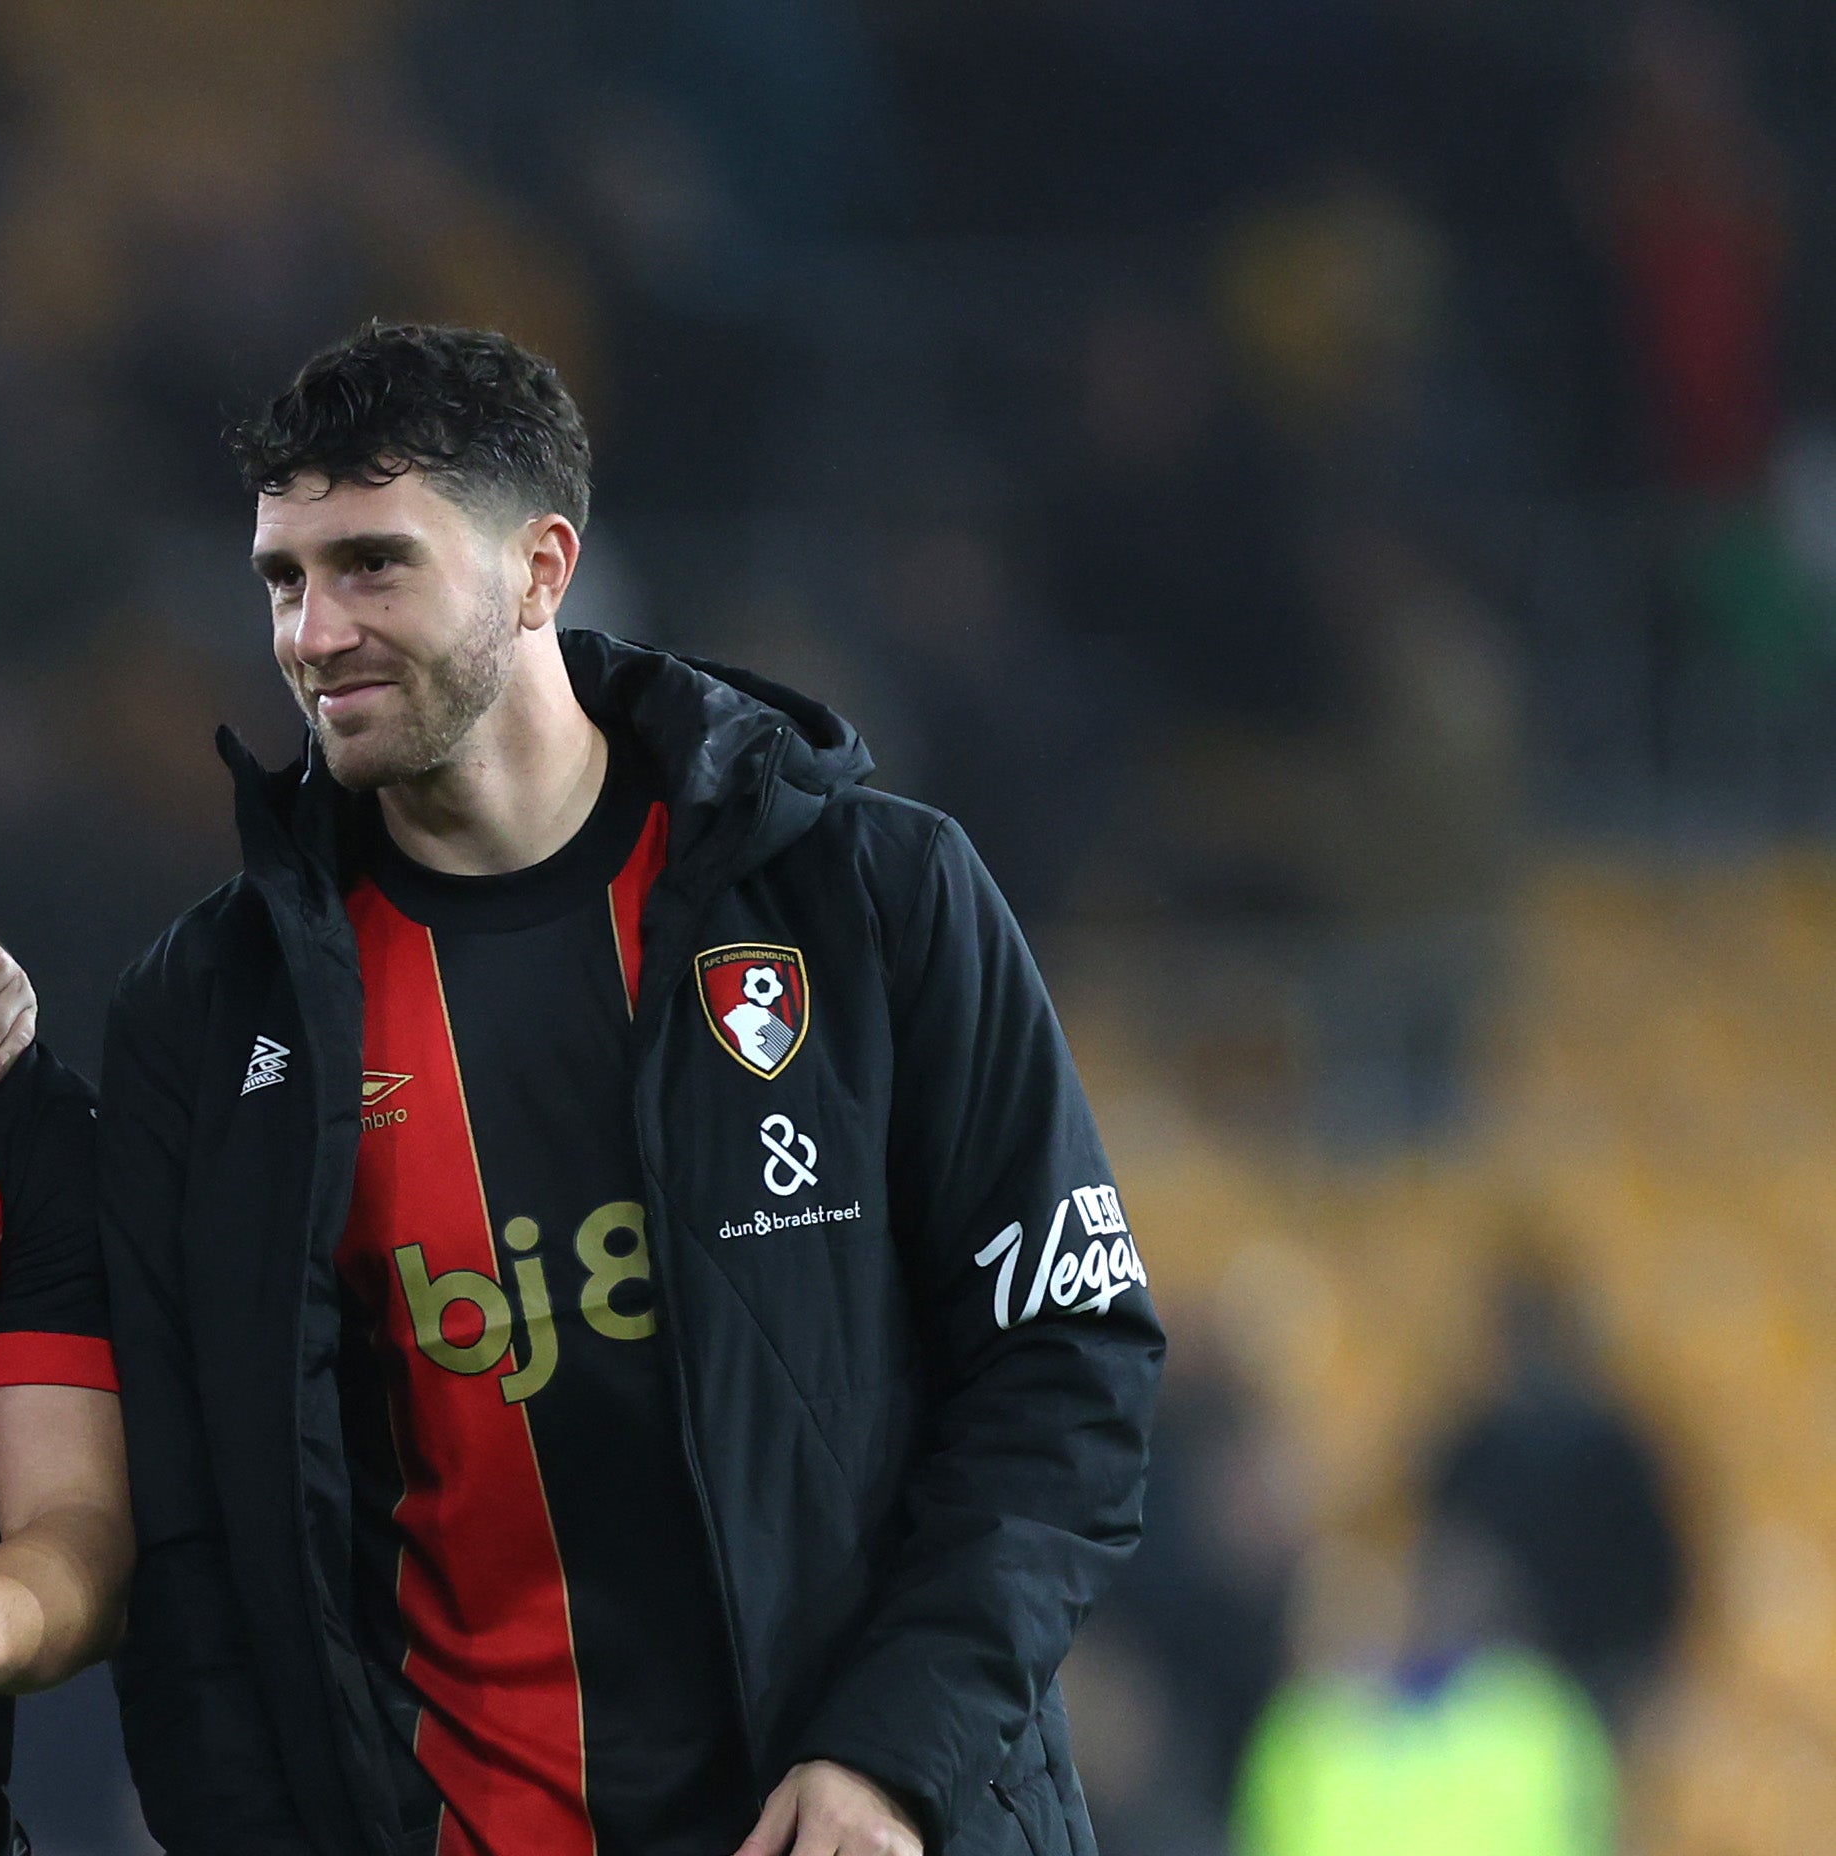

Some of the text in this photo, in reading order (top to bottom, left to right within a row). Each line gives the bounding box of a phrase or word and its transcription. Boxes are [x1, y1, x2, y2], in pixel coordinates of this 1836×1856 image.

[361, 1108, 408, 1132] mbro
[1076, 1188, 1124, 1233] LAS
[393, 1201, 657, 1405] bj8
